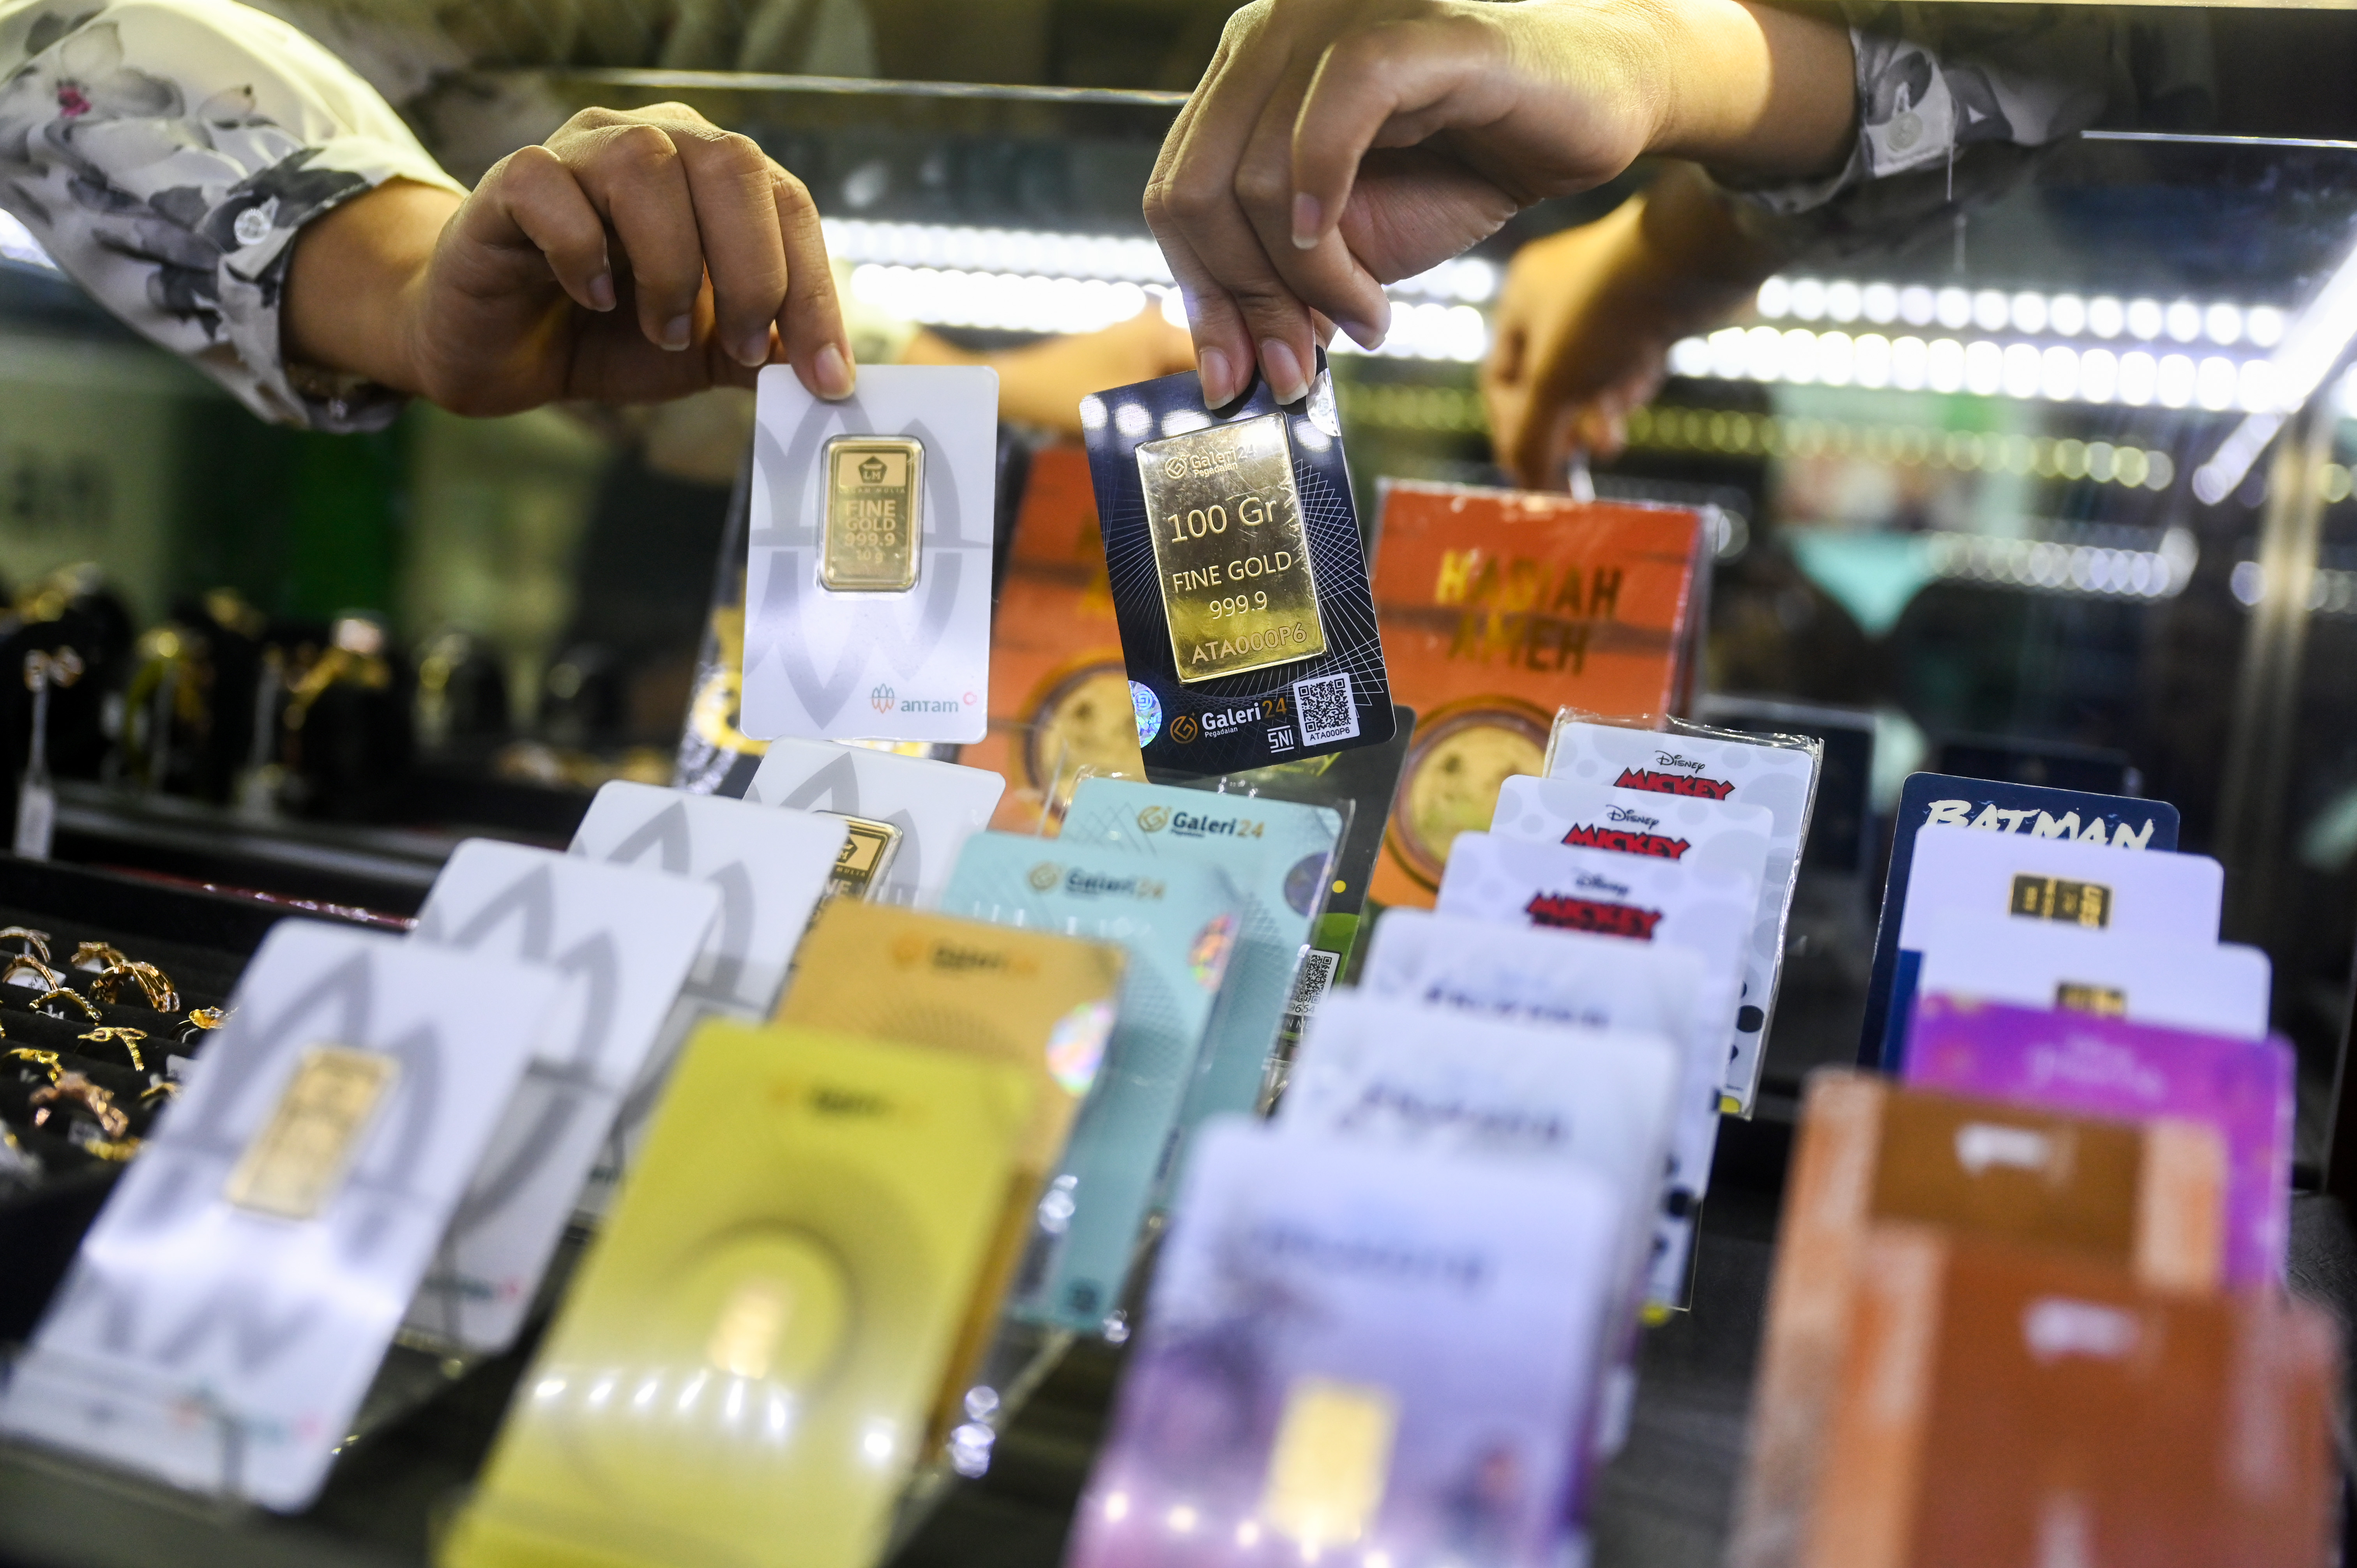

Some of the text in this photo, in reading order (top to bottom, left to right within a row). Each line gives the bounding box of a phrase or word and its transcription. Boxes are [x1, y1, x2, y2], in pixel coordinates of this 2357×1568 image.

[1193, 463, 1238, 478] Pegadaian
[846, 500, 896, 517] FINE
[847, 518, 896, 531] GOLD
[1168, 497, 1276, 543] 100 Gr
[845, 532, 895, 546] 999.9
[1172, 551, 1292, 593] FINE GOLD
[1209, 591, 1267, 620] 999.9
[1192, 622, 1307, 664] ATA000P6
[901, 700, 959, 712] antam
[1205, 726, 1238, 738] Pegadaian
[1267, 729, 1294, 749] SNI
[1310, 727, 1351, 741] ATA000P6
[1613, 766, 1735, 800] MICKEY
[1924, 800, 2154, 851] BATMAN
[1560, 822, 1691, 861] MICKEY
